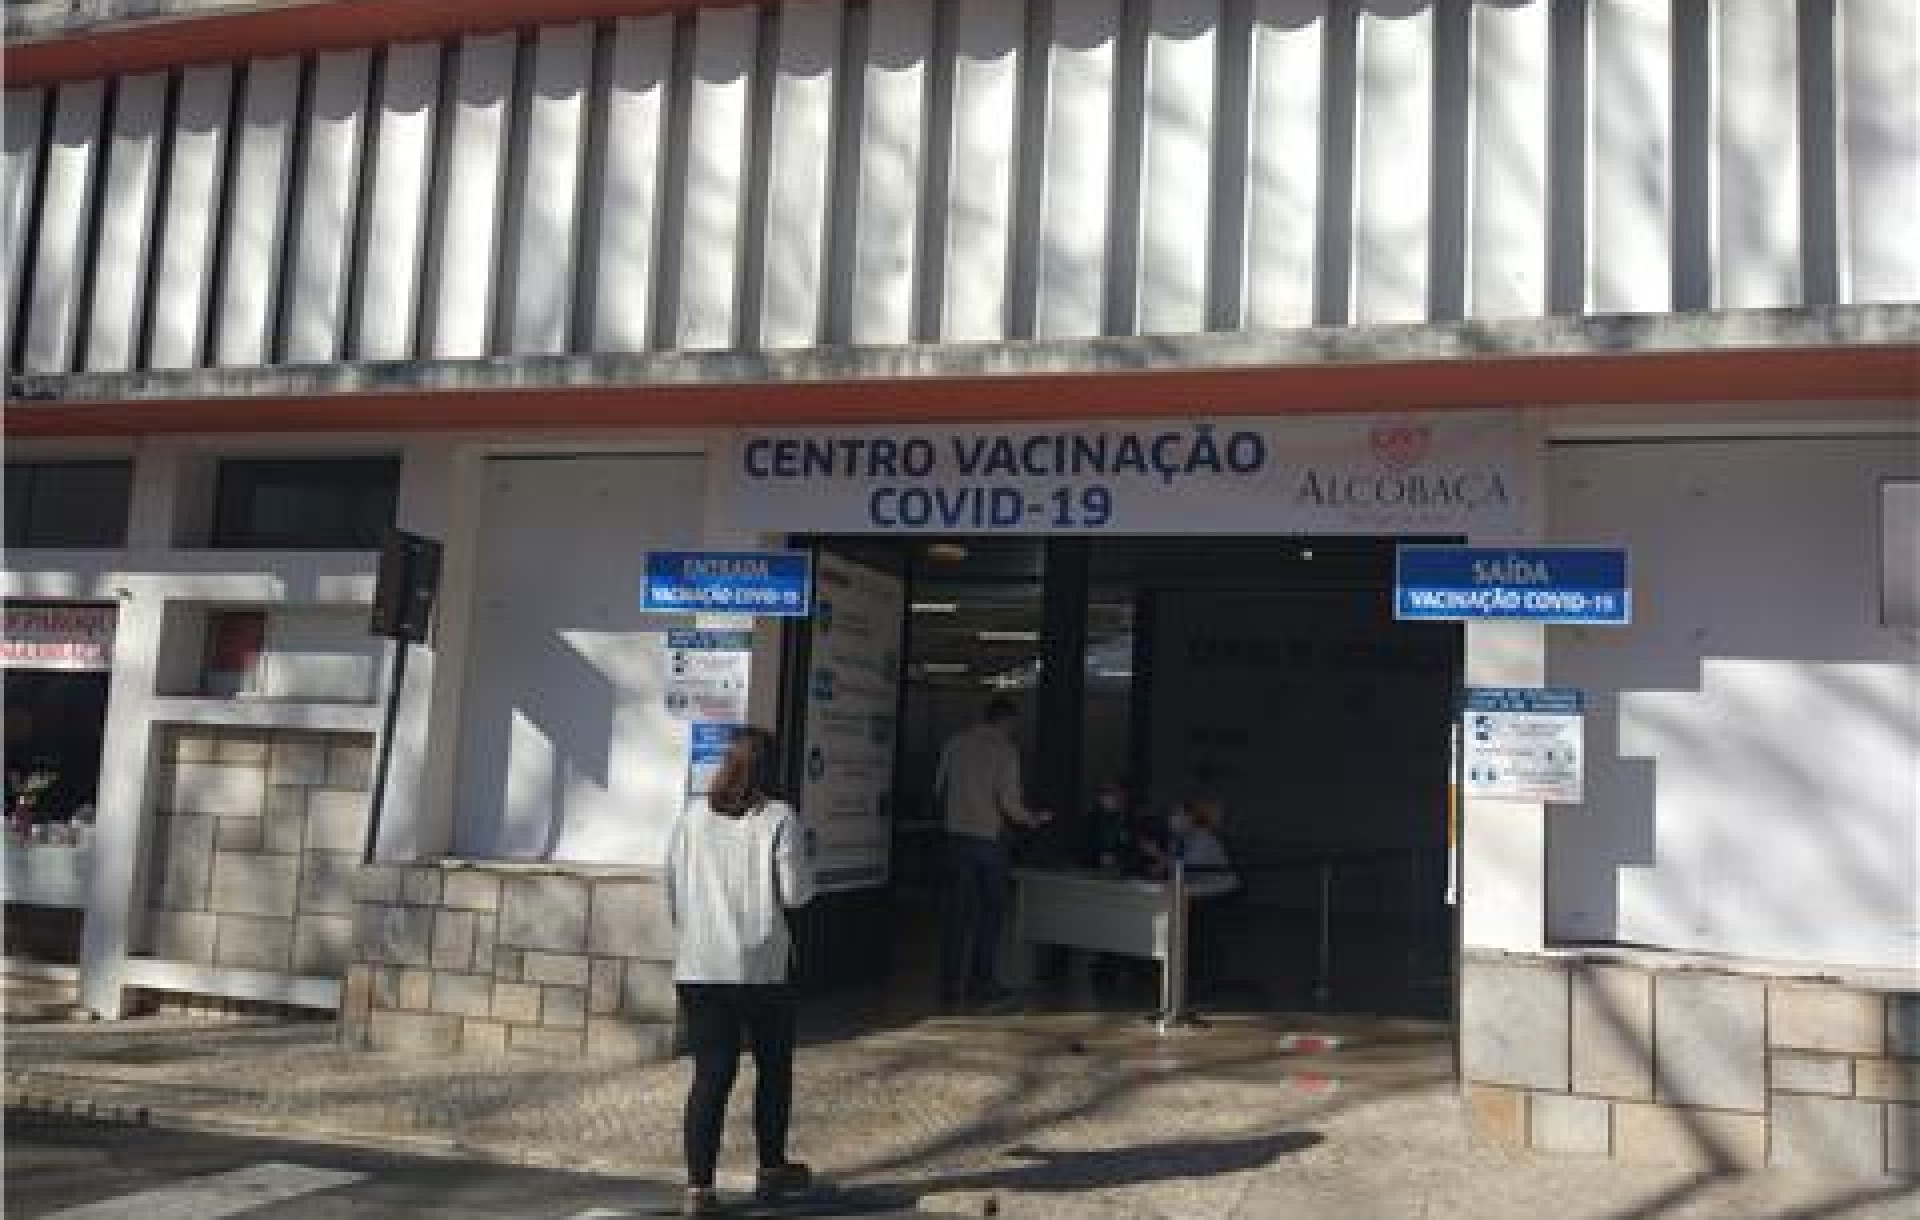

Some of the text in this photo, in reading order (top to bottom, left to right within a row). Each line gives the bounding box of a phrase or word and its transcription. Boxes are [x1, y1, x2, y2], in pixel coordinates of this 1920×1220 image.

[743, 423, 1267, 484] CENTRO VACINAÇÃO
[868, 484, 1114, 528] COVID-19
[1471, 553, 1552, 585] SAÍDA
[1410, 587, 1522, 613] VACINAÇÃO
